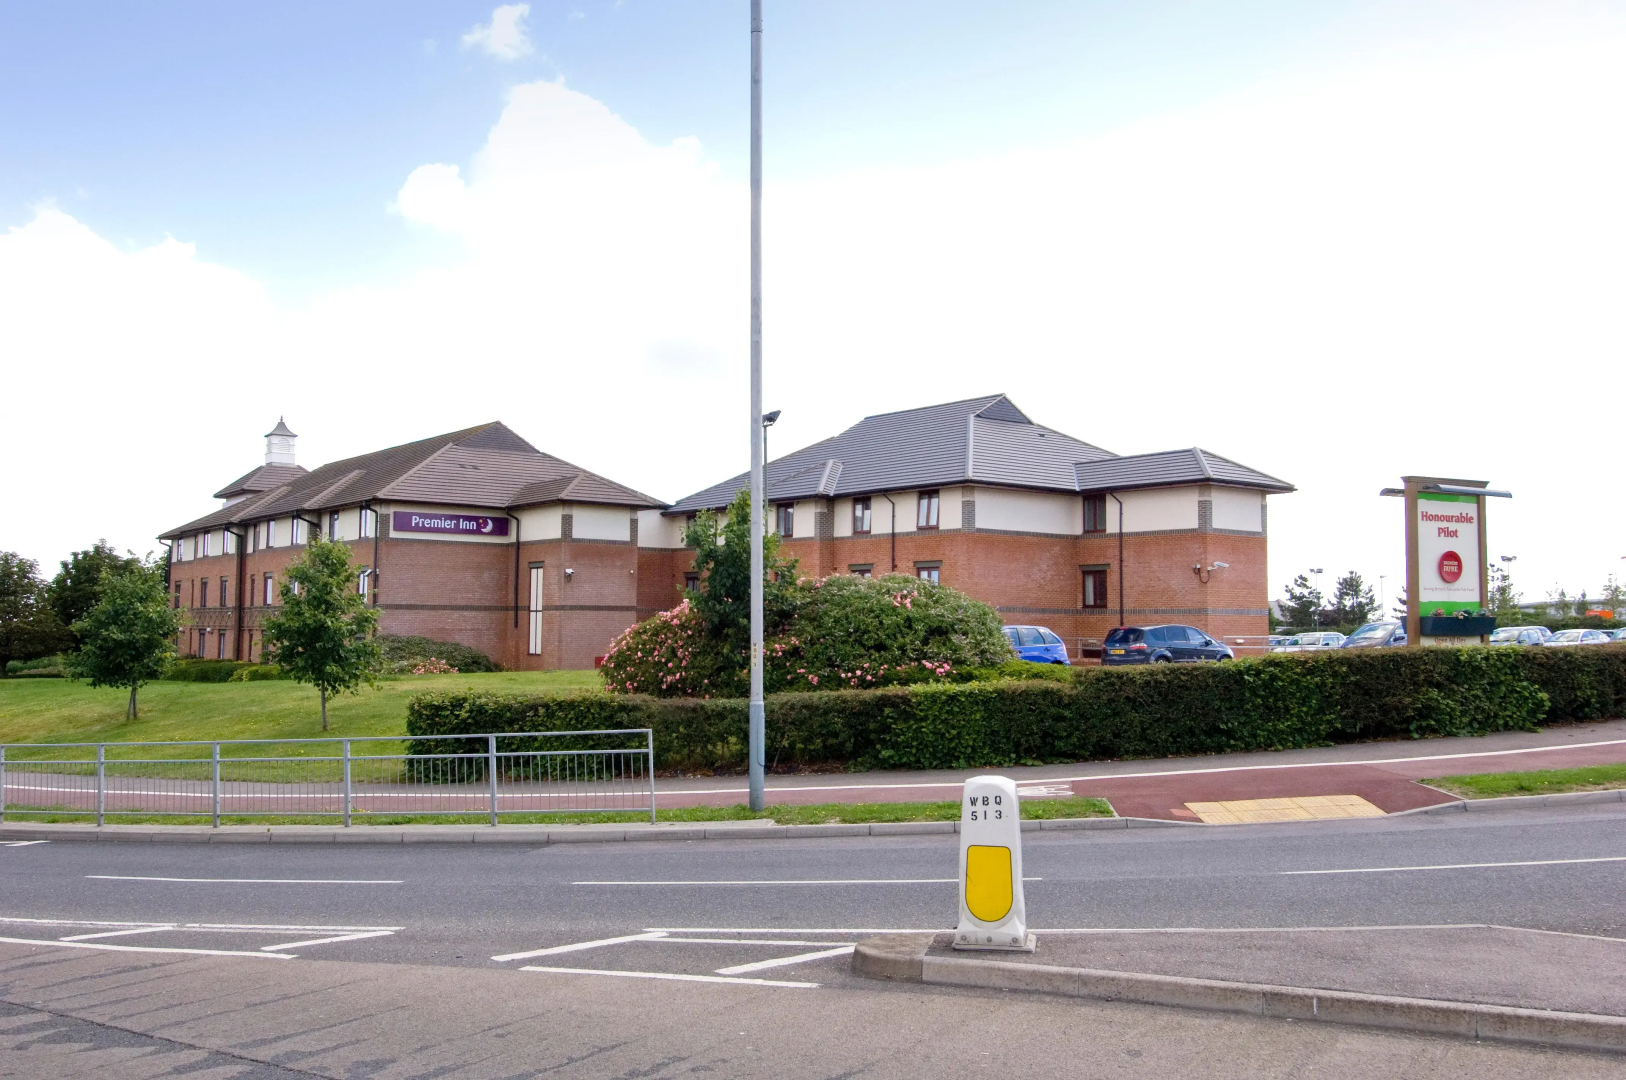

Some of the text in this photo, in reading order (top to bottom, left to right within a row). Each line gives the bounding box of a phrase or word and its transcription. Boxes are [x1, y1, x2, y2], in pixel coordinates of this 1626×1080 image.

[411, 515, 477, 530] Premier Inn
[1420, 510, 1474, 524] Honourable
[1437, 526, 1459, 538] Pilot
